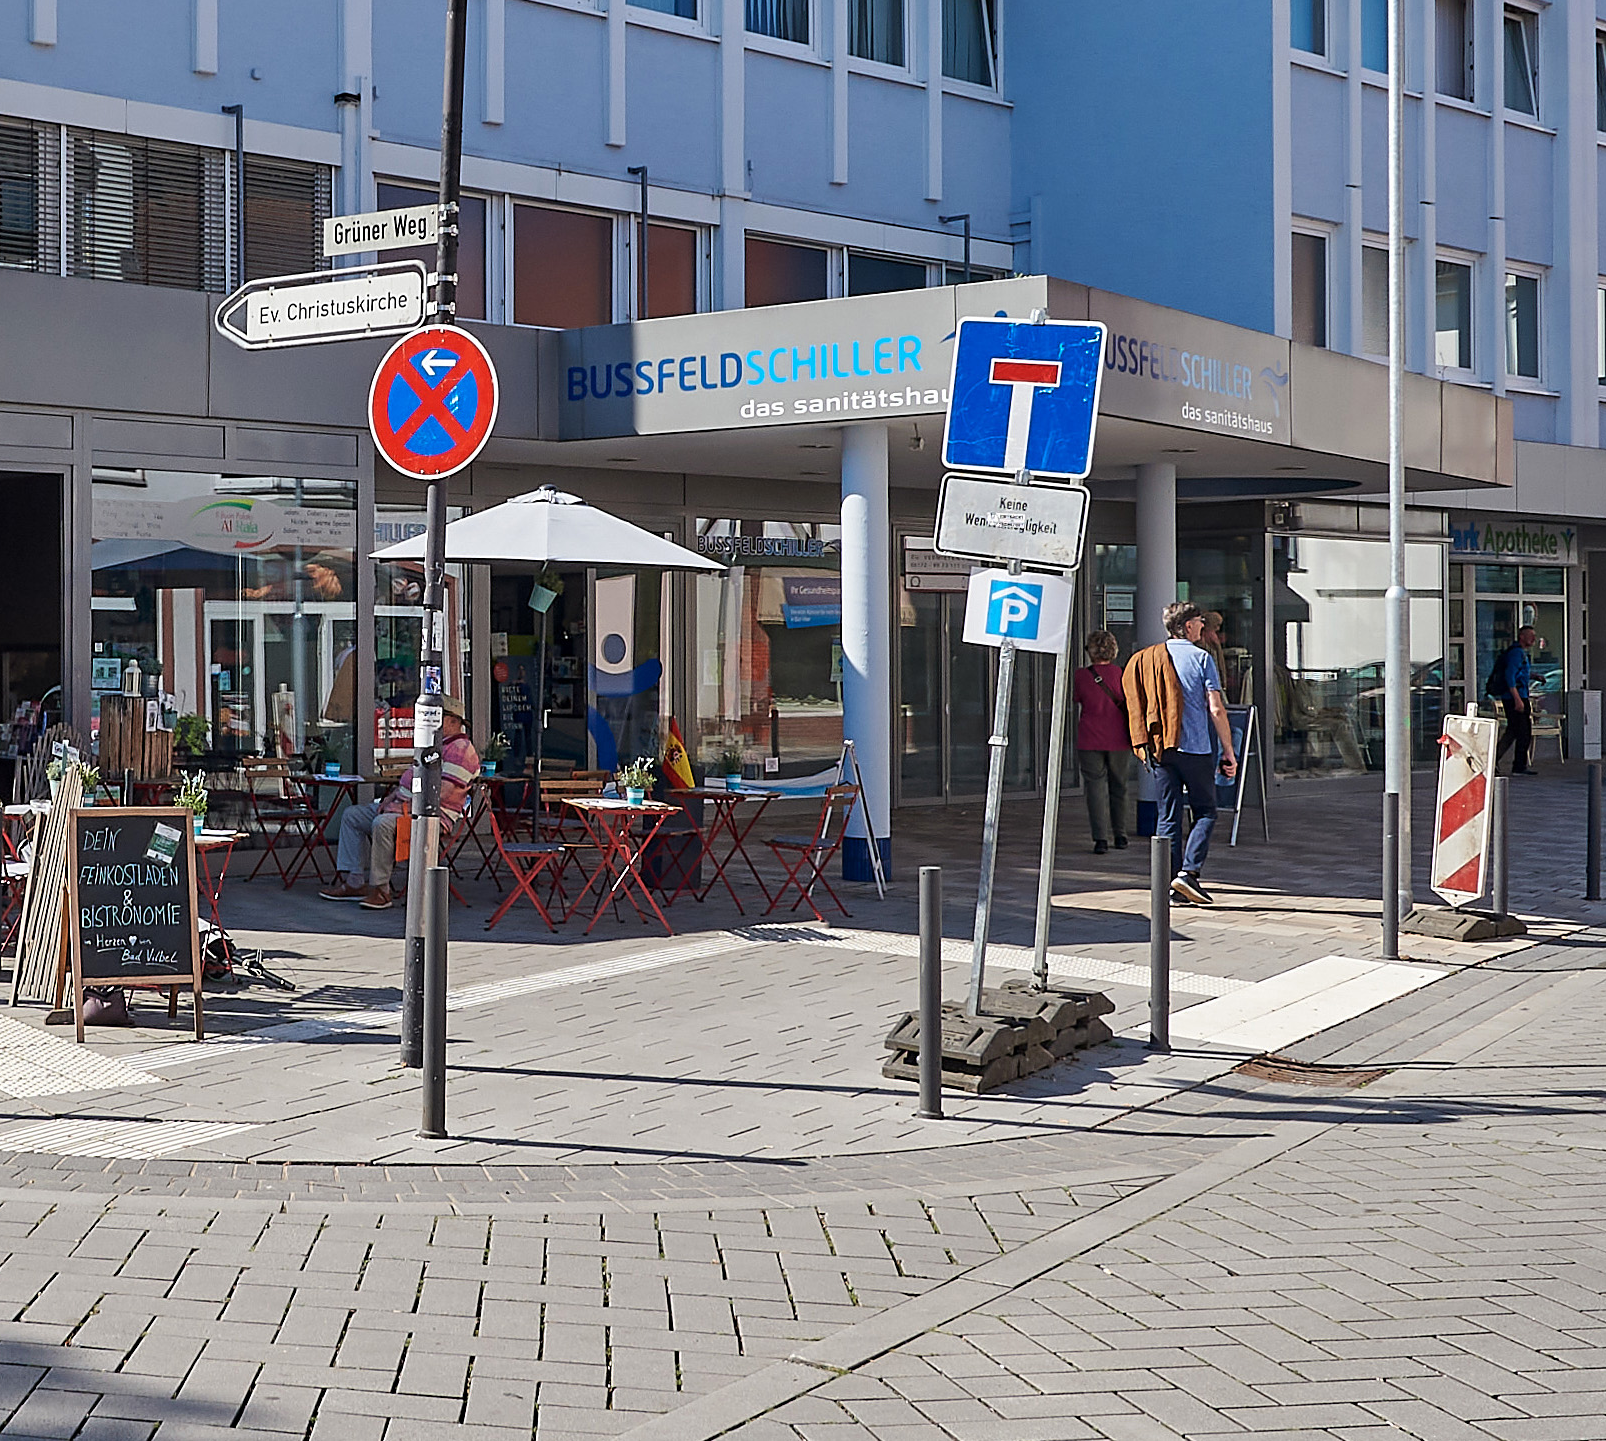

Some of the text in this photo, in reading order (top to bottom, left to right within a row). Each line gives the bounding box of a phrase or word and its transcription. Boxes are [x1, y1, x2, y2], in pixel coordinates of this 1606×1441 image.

[334, 214, 427, 245] Grüner Weg
[260, 291, 408, 324] Ev. Christuskirche
[567, 334, 923, 401] BUSSFELDSCHILLER
[1105, 333, 1253, 400] USSFELDSCHILLER
[740, 387, 951, 419] das sanitätshau
[1181, 402, 1273, 434] das sanitätshaus
[999, 497, 1028, 512] Keine
[697, 535, 824, 557] BUSSFELDSCHILLER
[1483, 523, 1558, 559] Apotheke
[1000, 598, 1029, 634] P
[83, 827, 122, 851] DEIN
[79, 863, 179, 887] FEINKOSTLADEN
[123, 889, 133, 906] &
[81, 902, 181, 929] BISTRONOMIE
[96, 934, 127, 948] Herzen
[122, 948, 178, 963] Bad Vilbel
